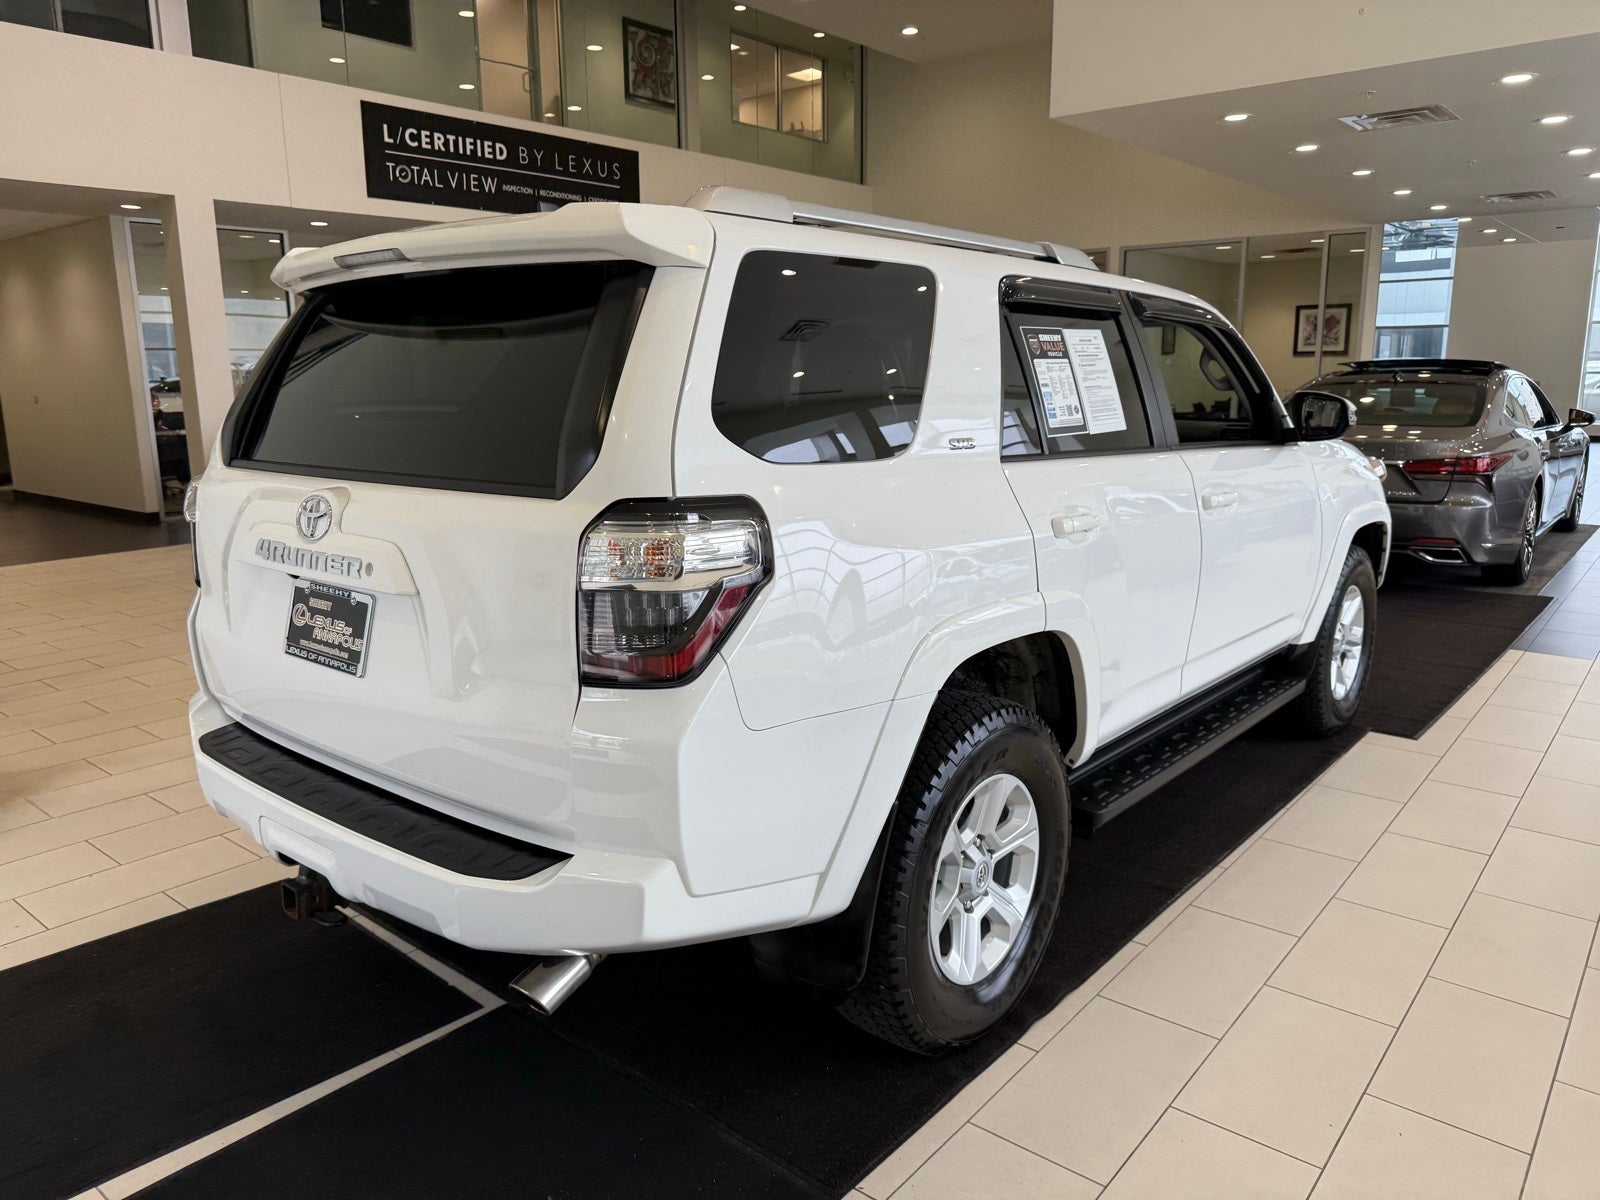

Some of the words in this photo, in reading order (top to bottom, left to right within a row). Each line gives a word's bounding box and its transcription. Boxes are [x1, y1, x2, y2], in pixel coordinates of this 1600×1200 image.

[519, 146, 544, 167] BY
[555, 152, 621, 180] LEXUS
[386, 162, 444, 188] TOTAL
[447, 170, 498, 194] VIEW
[502, 184, 534, 196] INSPECTION
[539, 189, 583, 202] RECONDITIONING
[1040, 341, 1066, 351] VALUE
[255, 538, 363, 579] 4RUNNER
[310, 583, 350, 598] SHEEHY
[306, 612, 346, 633] LEXUS
[313, 627, 363, 651] ANNAPOLIS
[286, 645, 308, 658] LEXUS
[308, 652, 318, 661] OF
[317, 656, 357, 673] ANNAPOLIS
